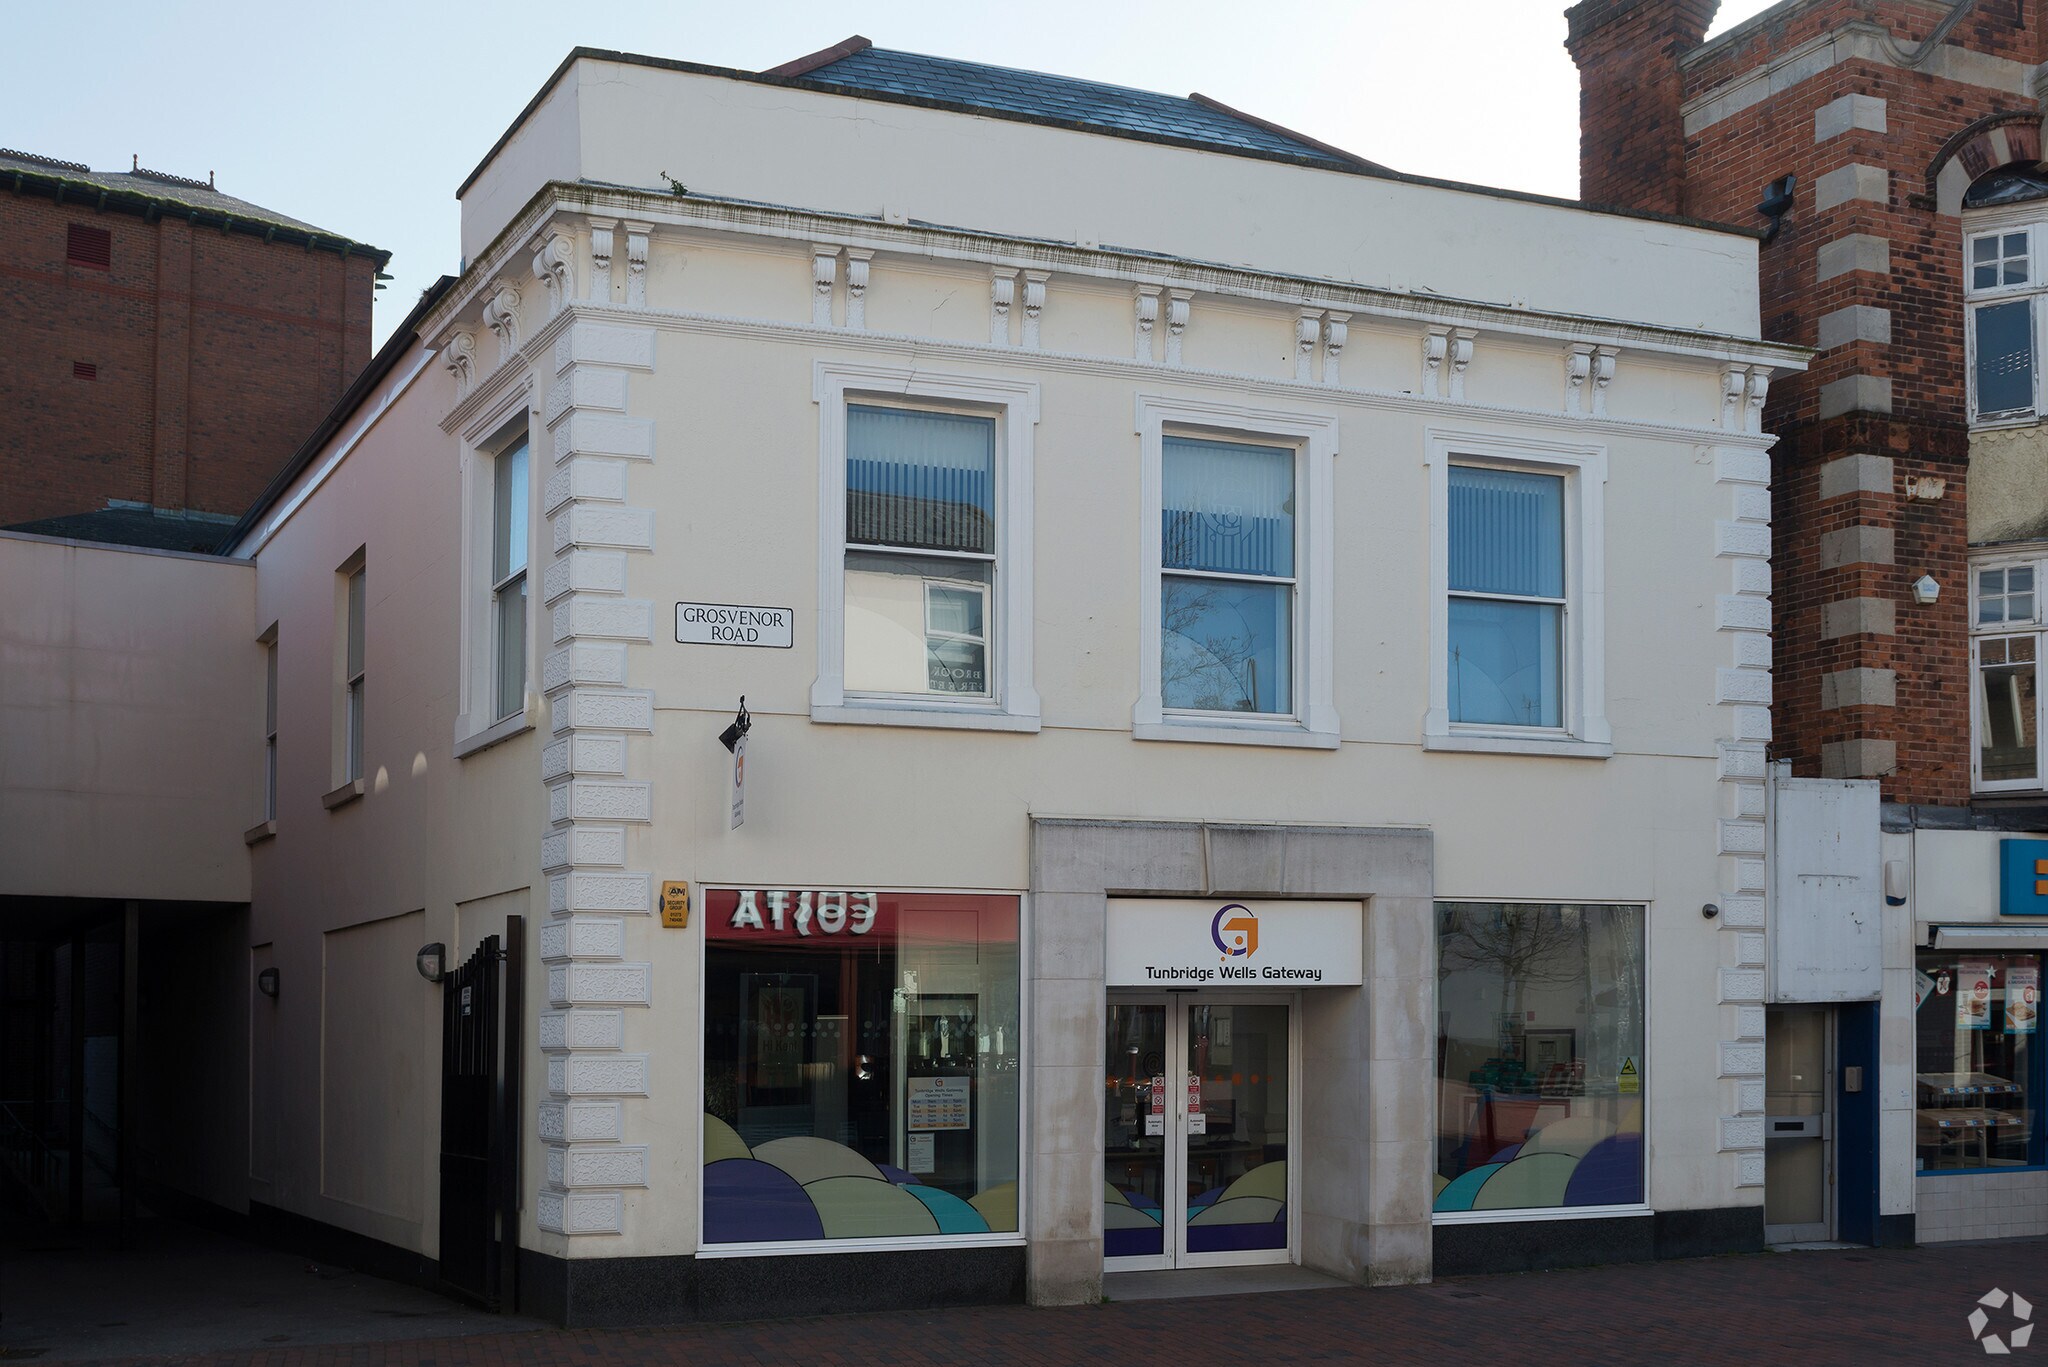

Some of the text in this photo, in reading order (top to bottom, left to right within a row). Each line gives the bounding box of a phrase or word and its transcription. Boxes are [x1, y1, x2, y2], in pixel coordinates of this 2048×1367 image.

[683, 607, 784, 627] GROSVENOR
[711, 626, 758, 642] ROAD
[1145, 966, 1322, 982] Tunbridge Wells Gateway
